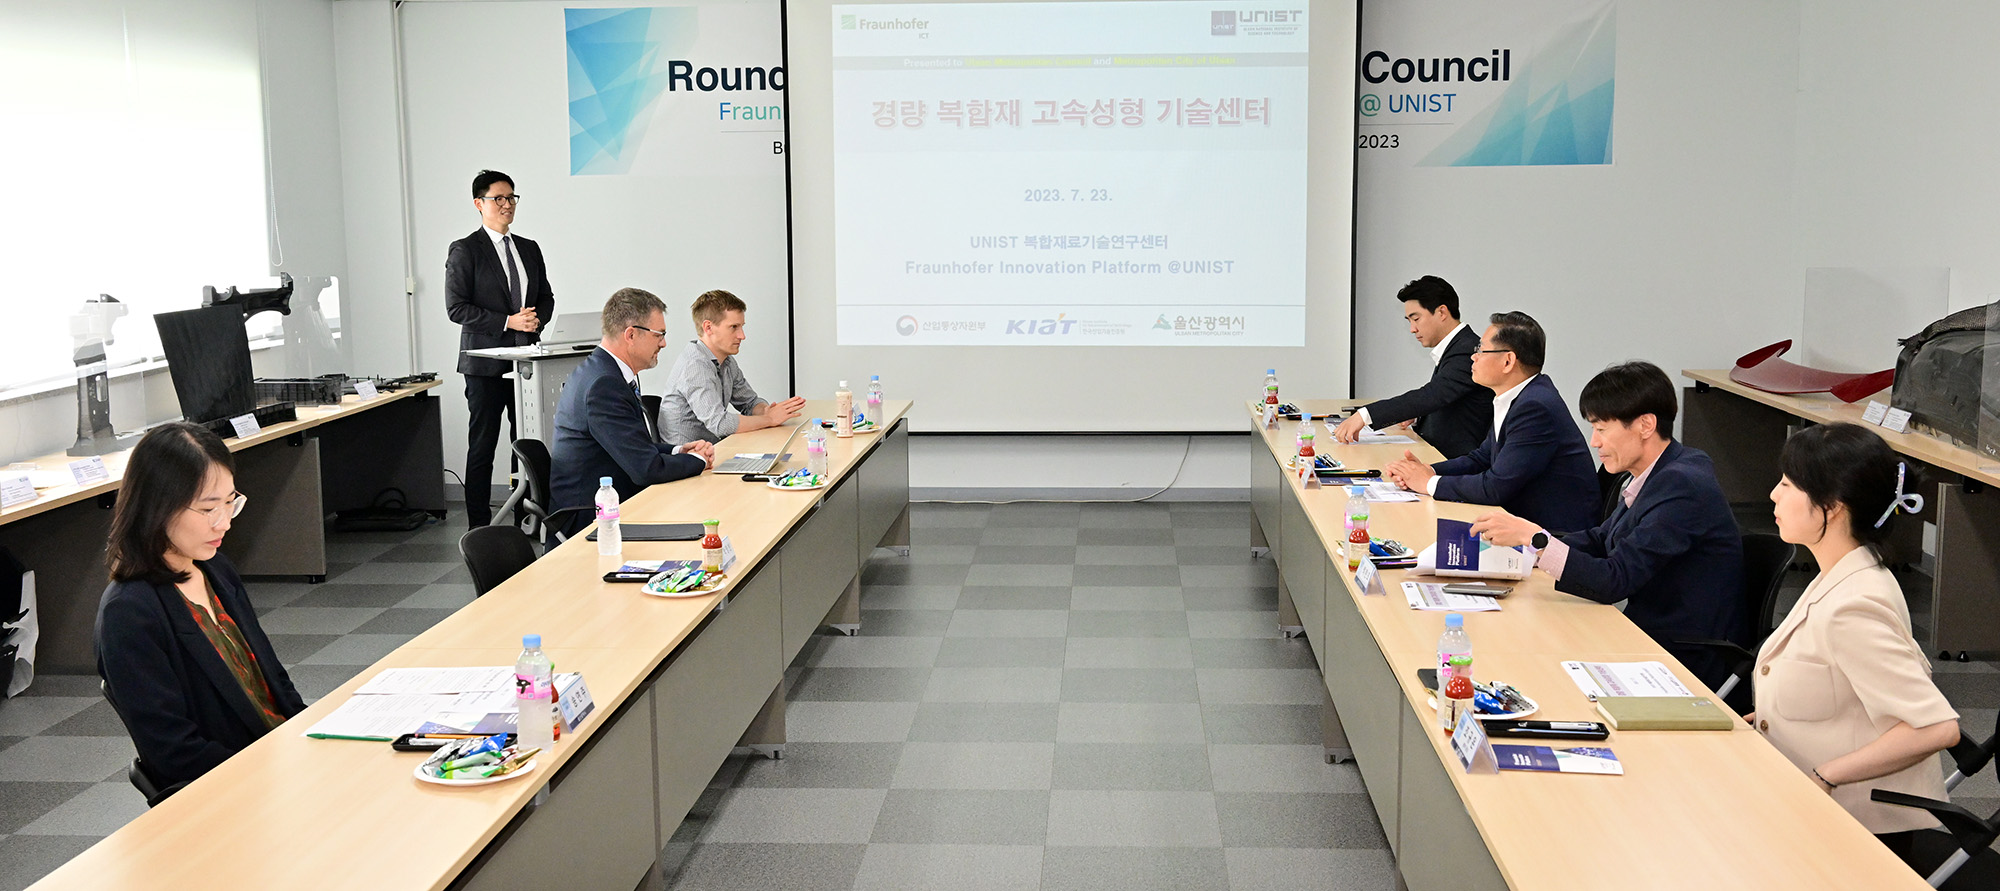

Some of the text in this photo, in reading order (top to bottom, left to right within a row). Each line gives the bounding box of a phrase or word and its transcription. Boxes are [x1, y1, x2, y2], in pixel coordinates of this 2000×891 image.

[860, 17, 929, 30] Fraunhofer
[904, 58, 951, 68] Presented
[953, 58, 963, 67] to
[1094, 57, 1111, 65] and
[1362, 49, 1511, 84] Council
[1359, 93, 1457, 117] @ UNIST
[872, 97, 1270, 128] 경량 복합재 고속성형 기술센터
[773, 142, 787, 155] B
[1358, 134, 1400, 149] 2023
[1024, 189, 1113, 202] 2023. 7. 23.
[970, 235, 1168, 250] UNIST 복합재료기술연구센터
[905, 260, 1235, 274] Fraunhofer Innovation Platform @UNIST
[922, 321, 986, 331] 산업통상자원부
[1174, 315, 1245, 331] 울산광역시
